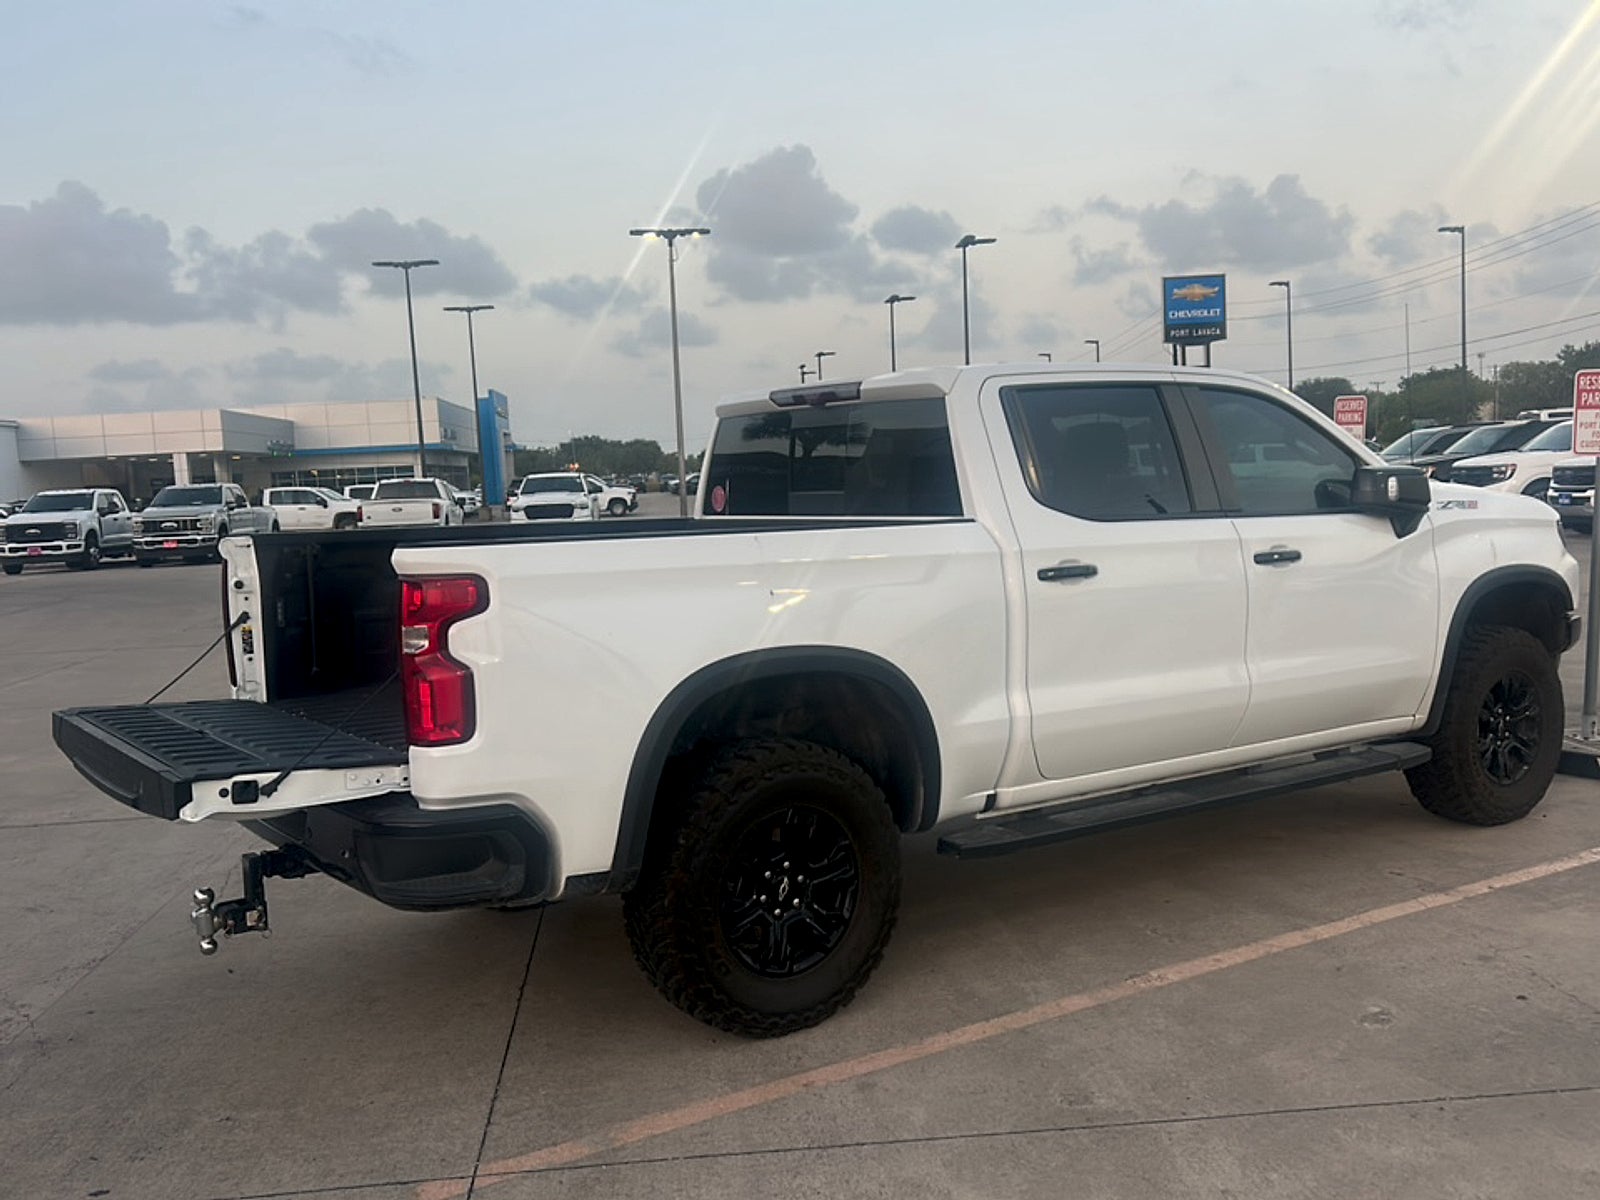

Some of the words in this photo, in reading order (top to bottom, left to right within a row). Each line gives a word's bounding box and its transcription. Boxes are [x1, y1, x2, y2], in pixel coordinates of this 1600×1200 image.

[1168, 308, 1221, 319] CHEVROLET
[1169, 328, 1190, 337] PORT
[1193, 327, 1221, 336] LAVACA
